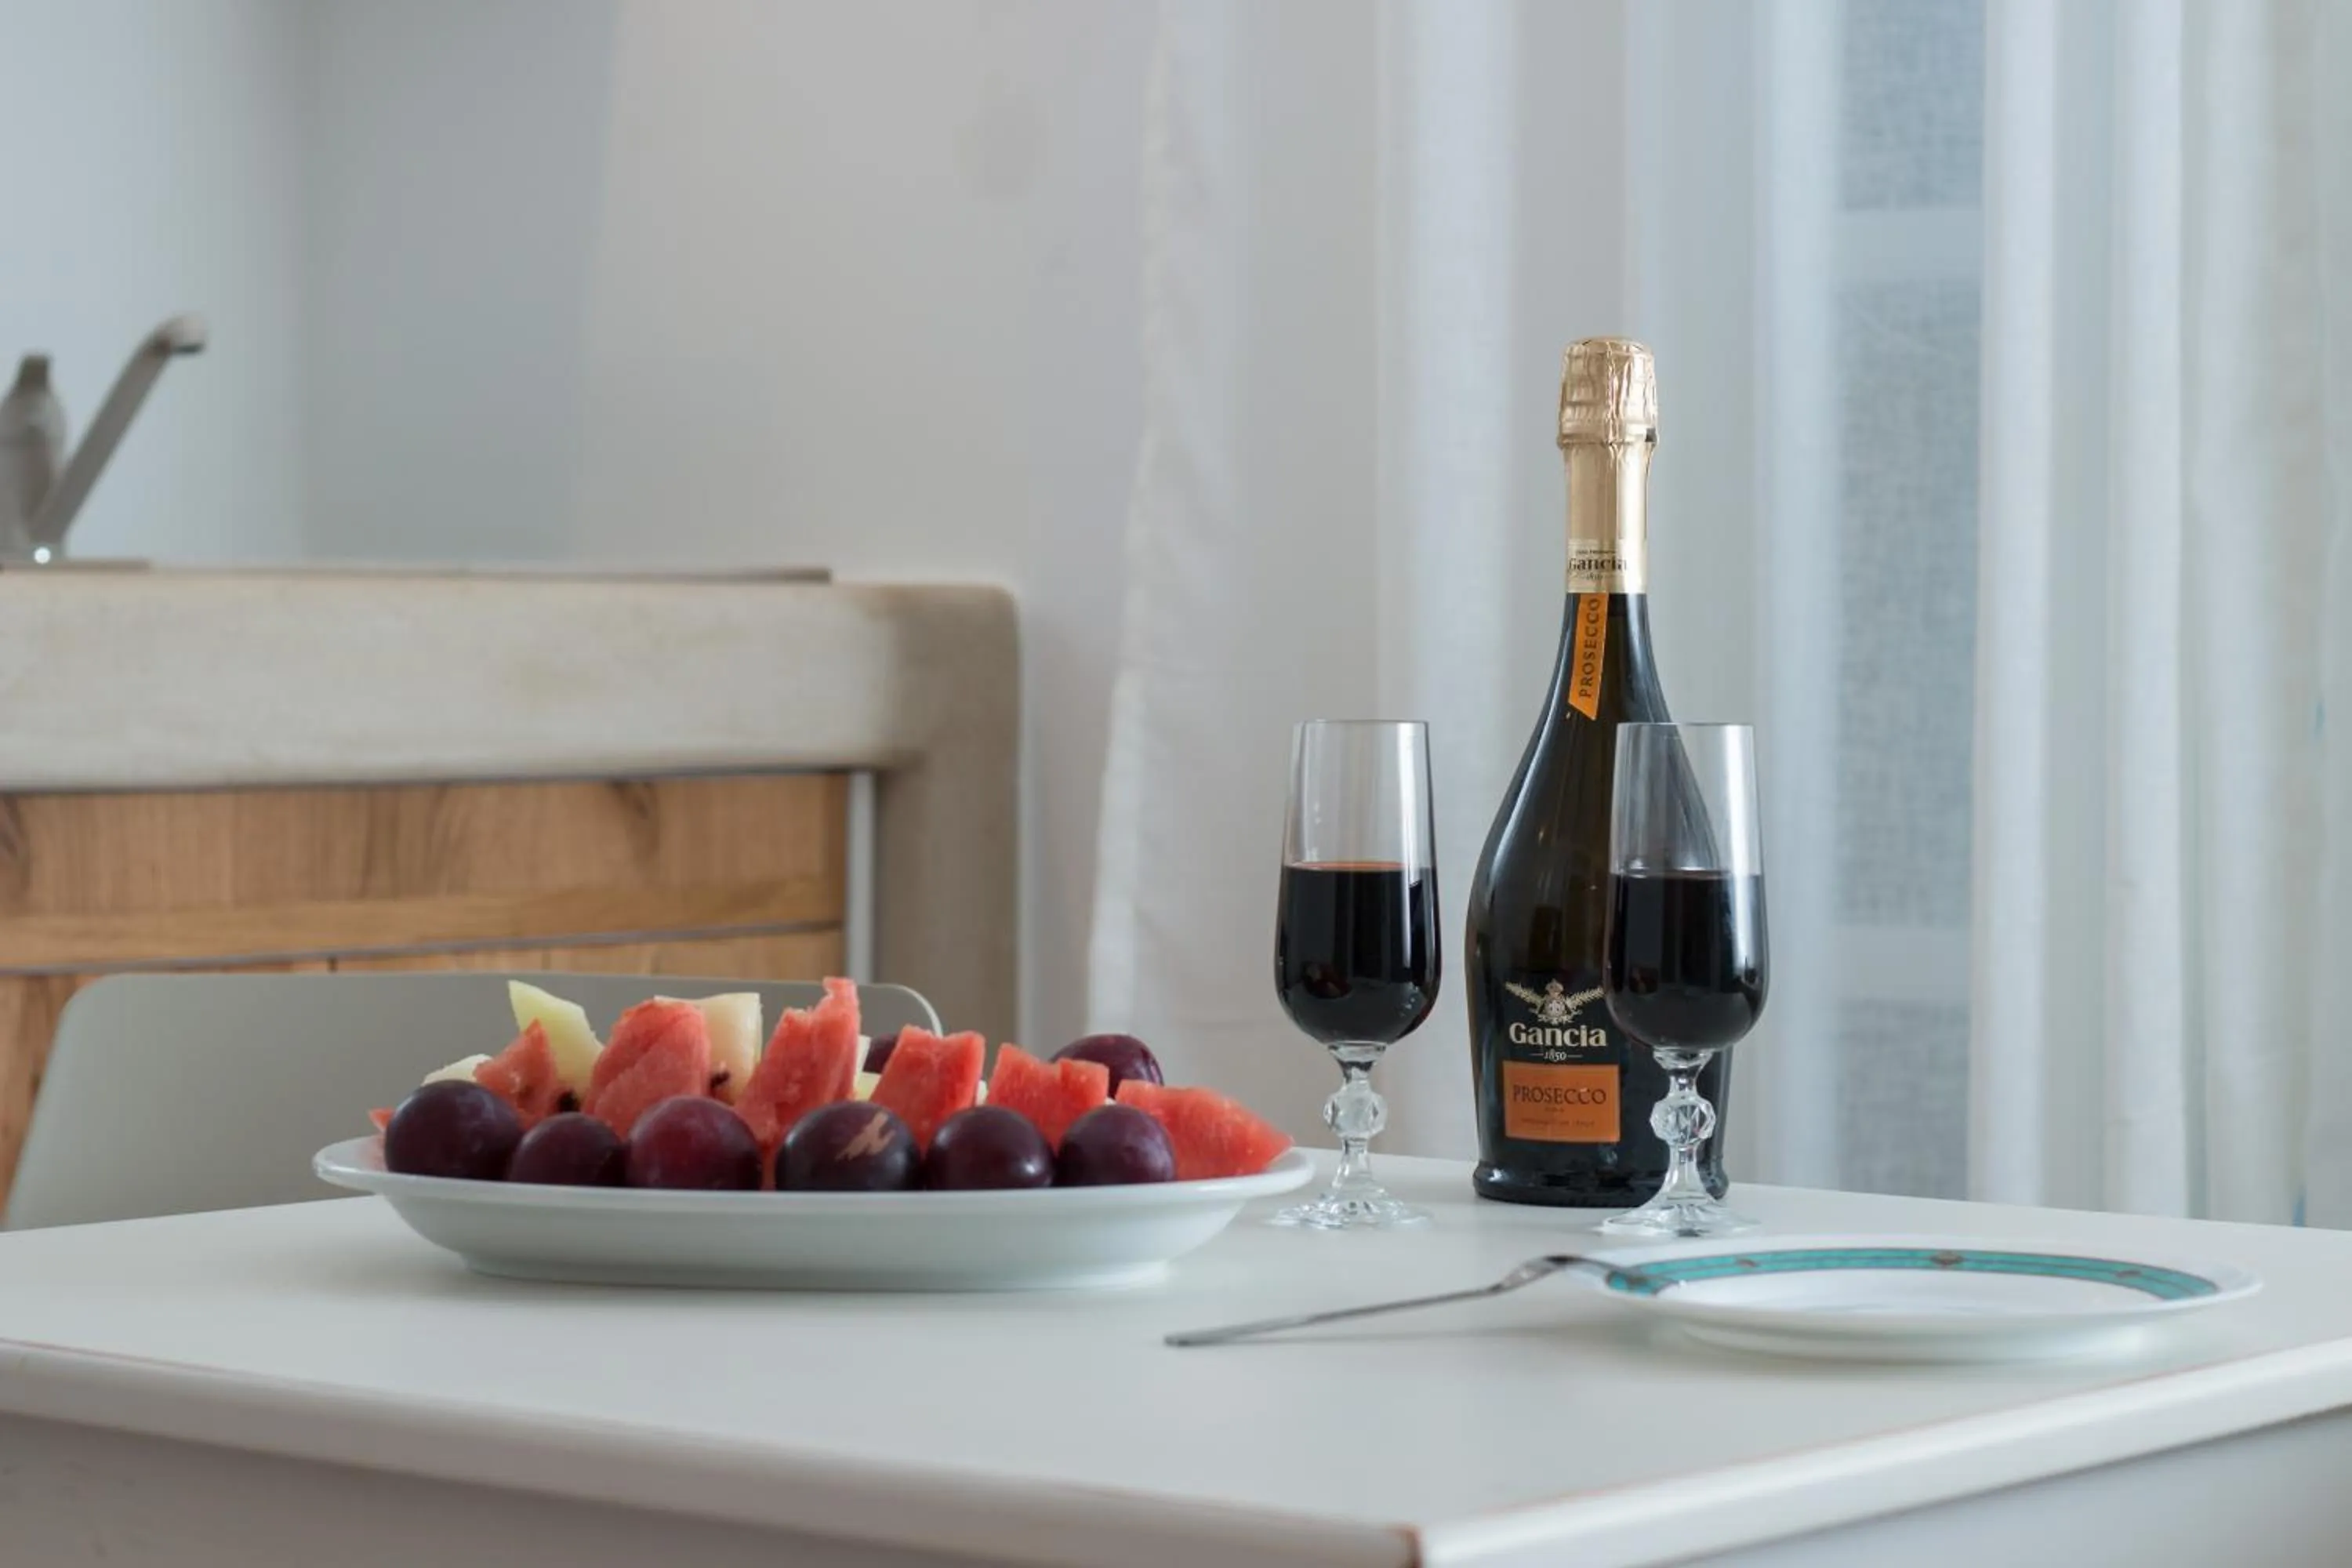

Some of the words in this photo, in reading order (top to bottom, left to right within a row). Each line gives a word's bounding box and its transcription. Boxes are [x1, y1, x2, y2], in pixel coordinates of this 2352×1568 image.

[1579, 598, 1601, 699] PROSECCO
[1509, 1022, 1607, 1047] Gancia
[1513, 1084, 1607, 1105] PROSECCO
